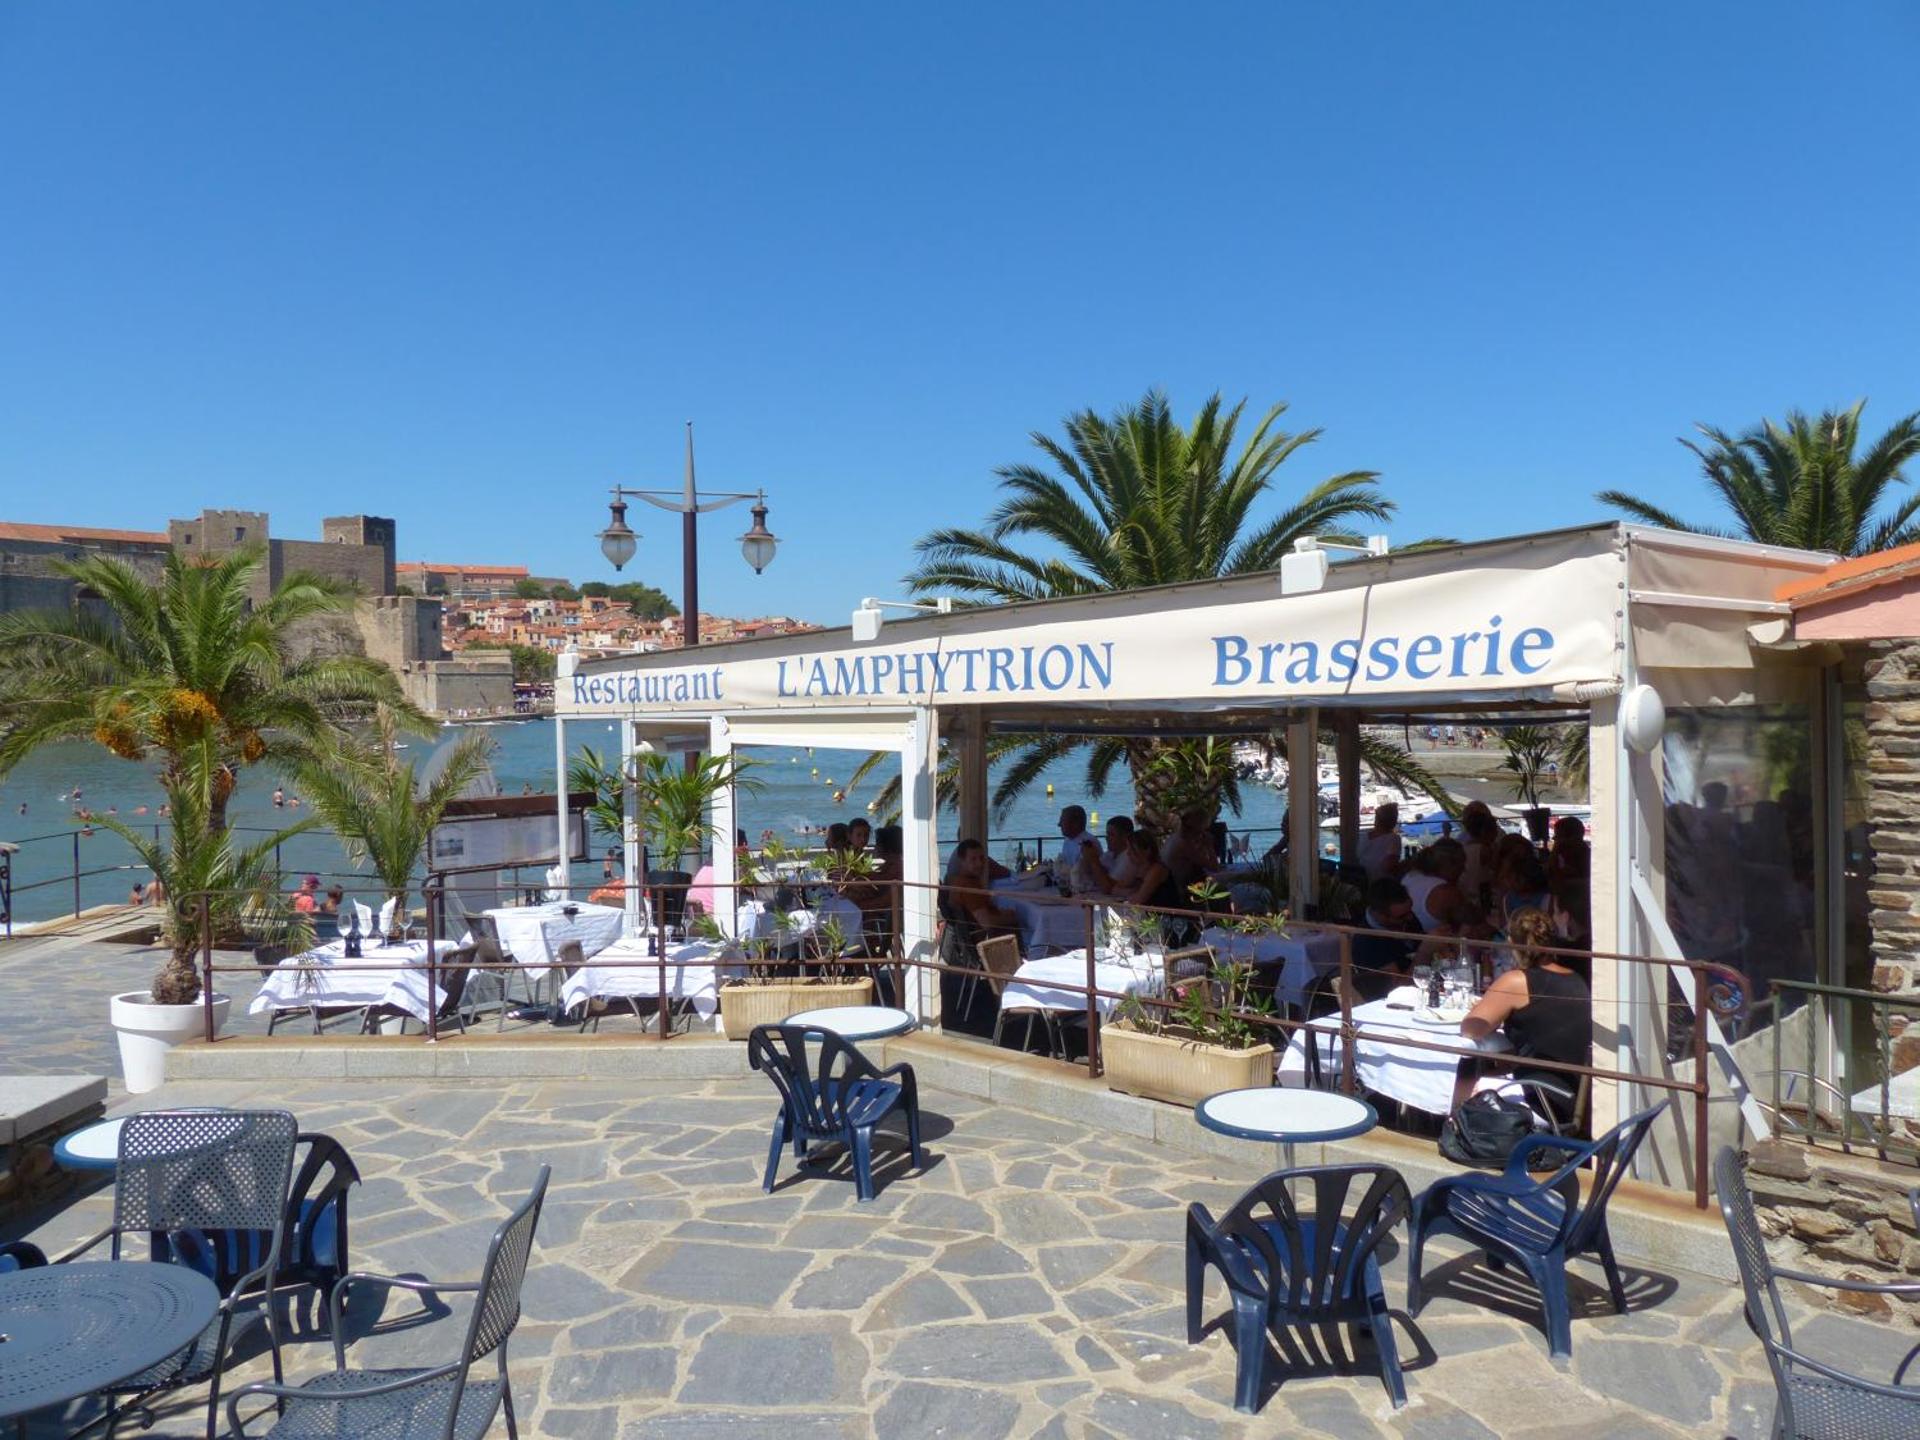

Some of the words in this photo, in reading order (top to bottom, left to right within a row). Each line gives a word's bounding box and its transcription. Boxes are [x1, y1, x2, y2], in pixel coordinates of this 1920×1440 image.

[573, 664, 723, 706] Restaurant
[777, 641, 1115, 698] L'AMPHYTRION
[1211, 614, 1555, 687] Brasserie
